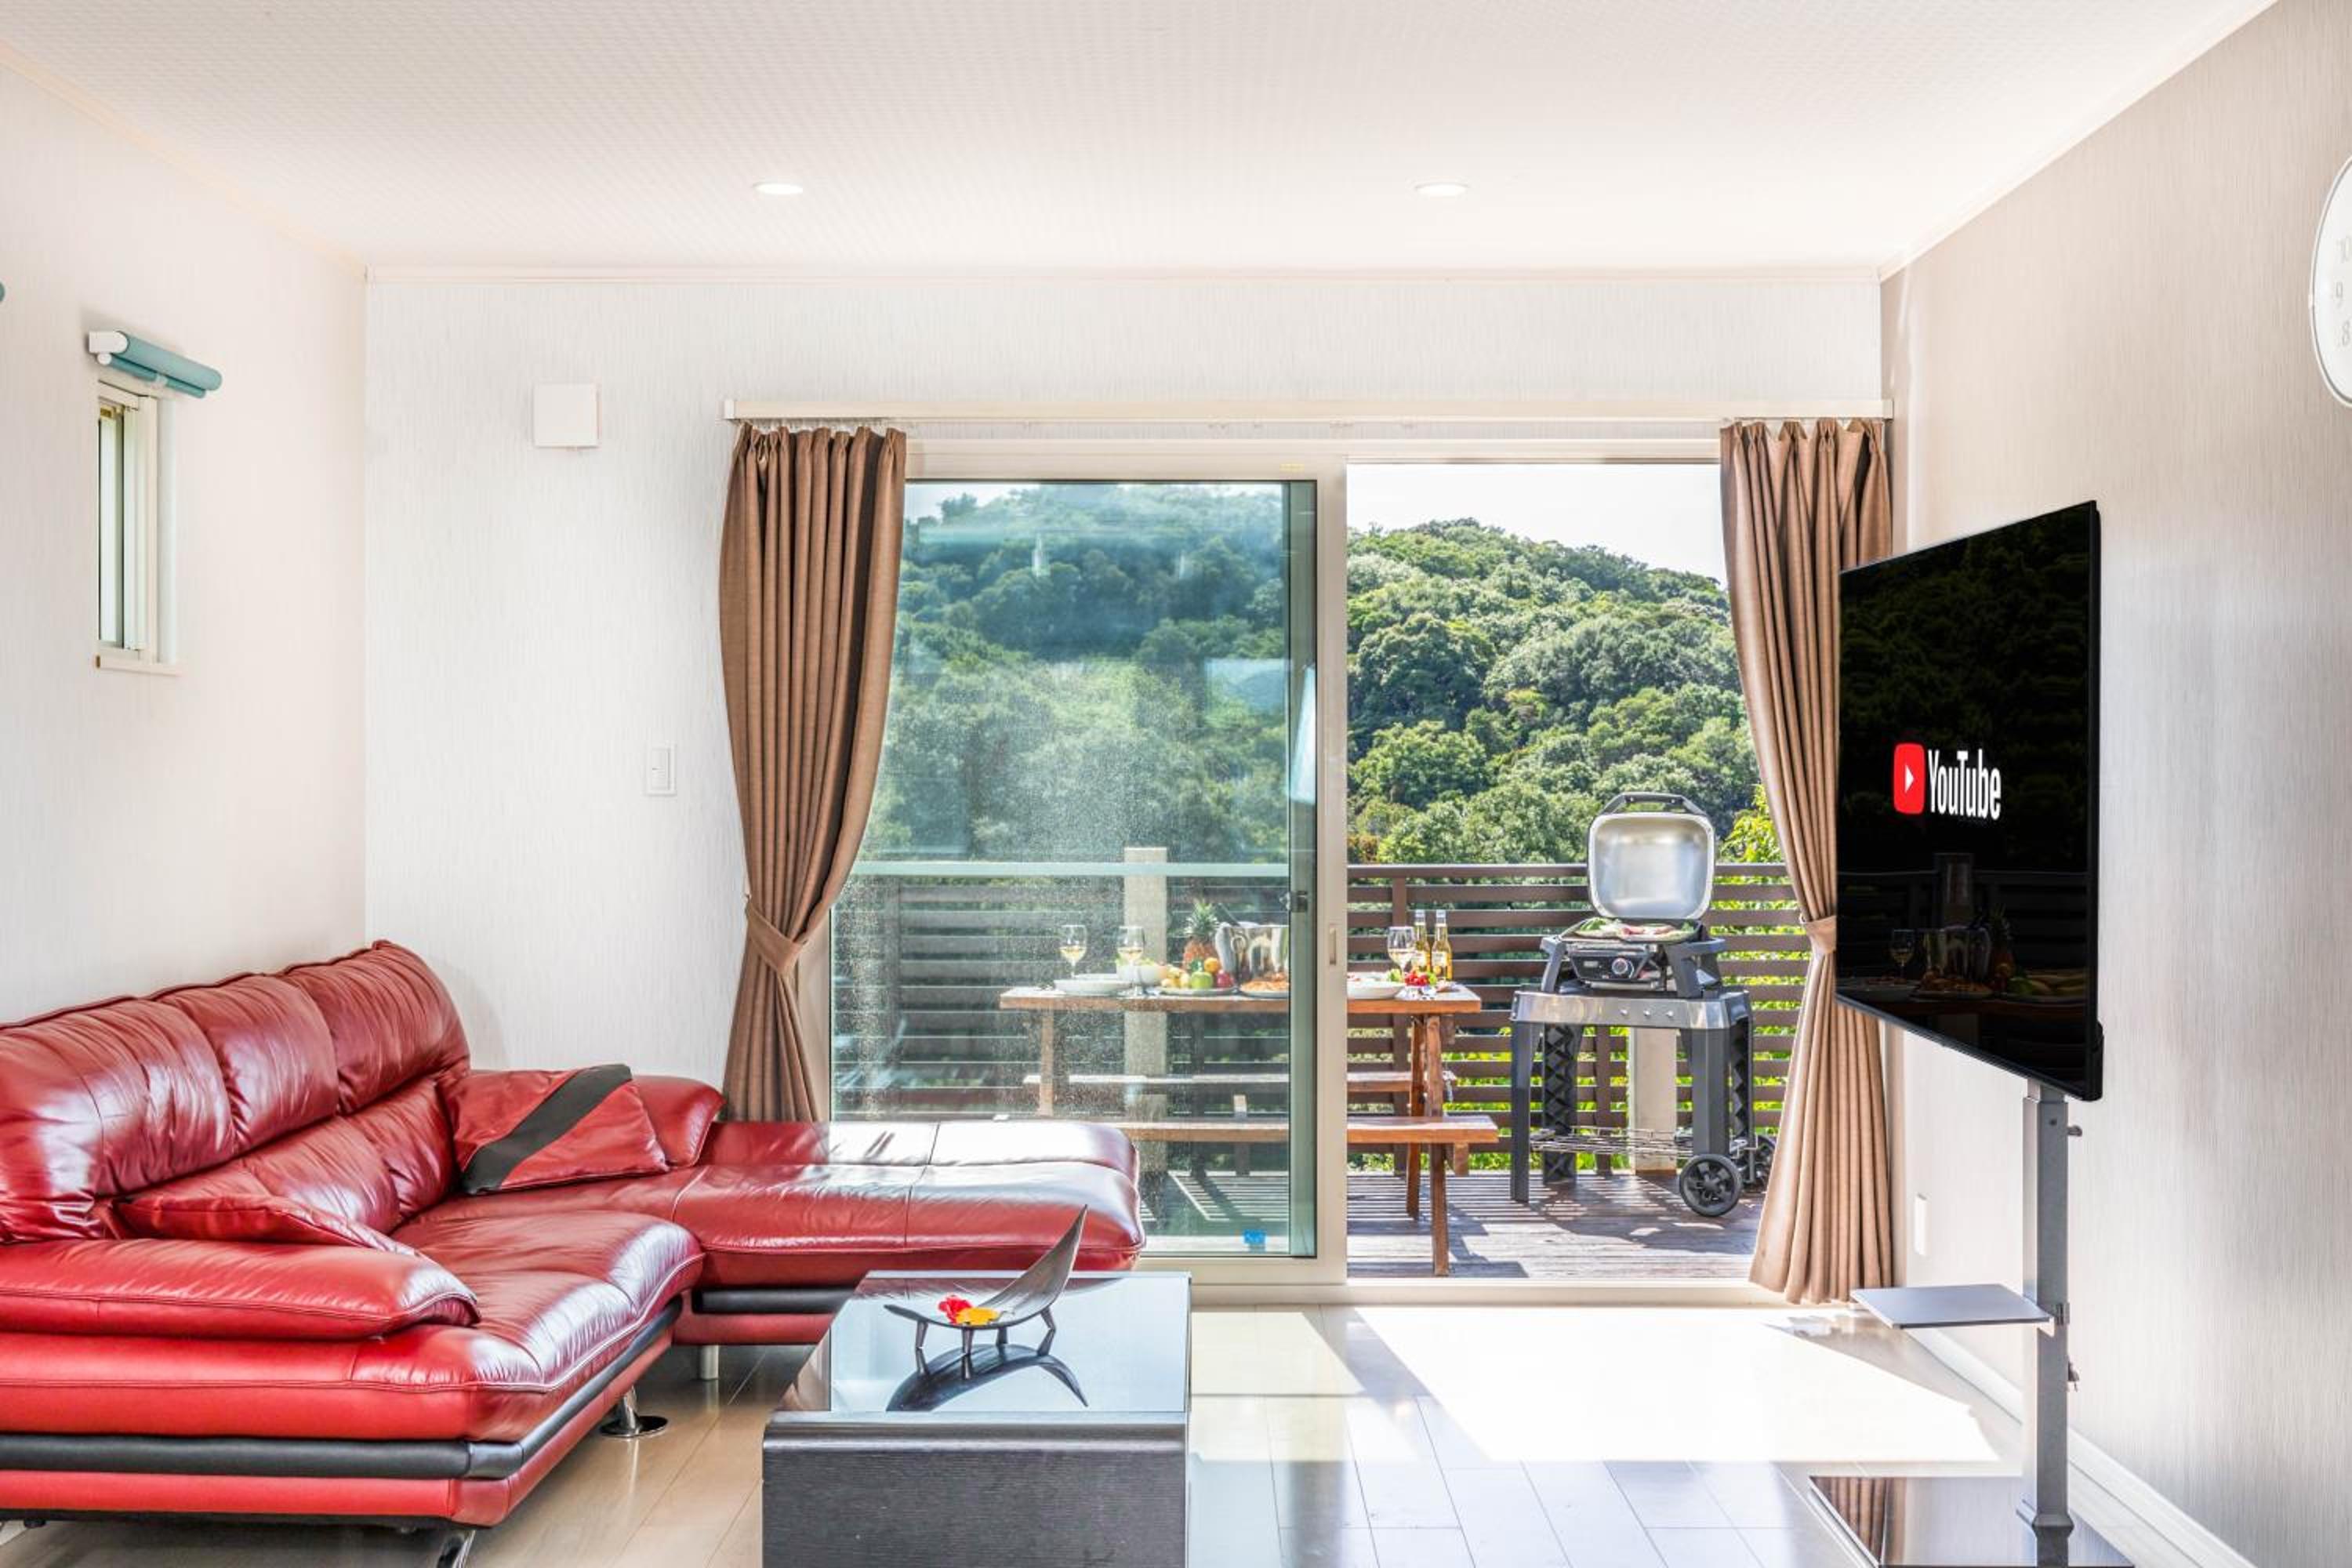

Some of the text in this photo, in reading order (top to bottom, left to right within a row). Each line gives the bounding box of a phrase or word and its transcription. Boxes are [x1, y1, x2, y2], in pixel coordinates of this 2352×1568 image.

[2336, 281, 2343, 309] 9
[2341, 320, 2350, 347] 8
[1928, 748, 2002, 820] YouTube
